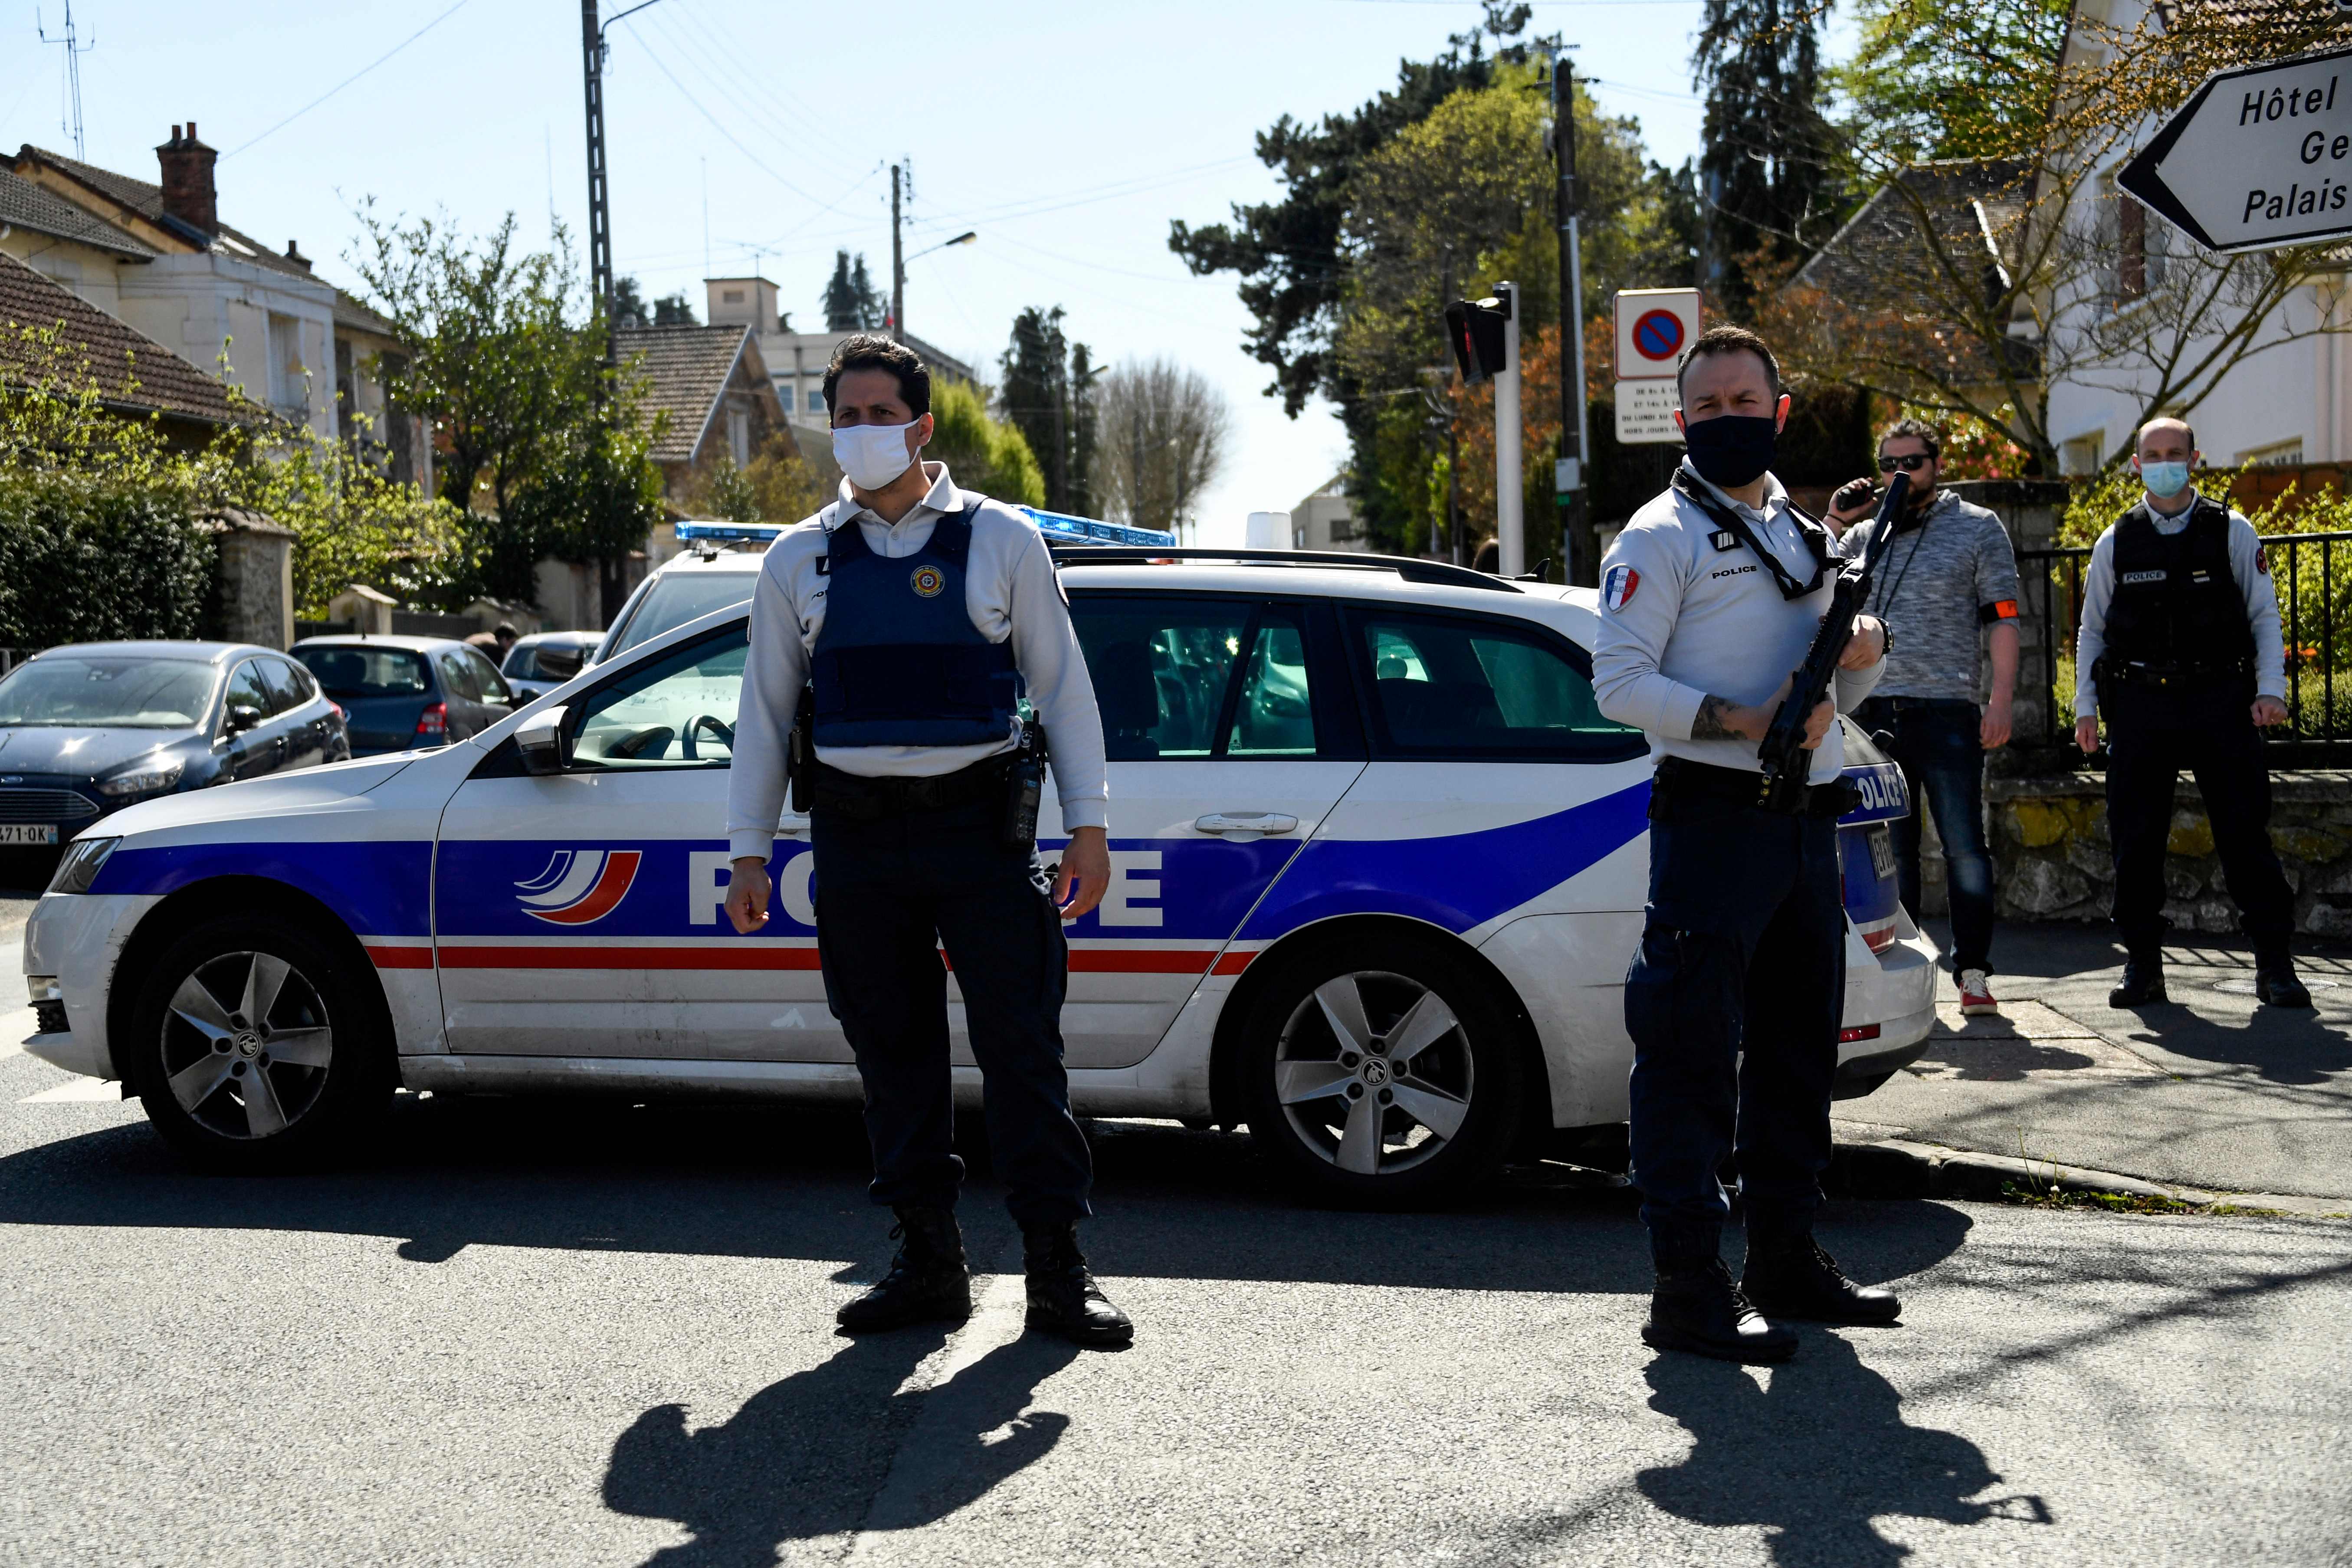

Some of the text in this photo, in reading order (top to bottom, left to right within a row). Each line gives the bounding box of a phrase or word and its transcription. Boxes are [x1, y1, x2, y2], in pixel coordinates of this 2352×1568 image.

[2239, 76, 2338, 126] Hôtel
[2300, 131, 2349, 164] Ge
[2242, 178, 2347, 223] Palais
[1712, 566, 1757, 579] POLICE
[2126, 571, 2163, 581] POLICE
[1849, 774, 1901, 814] OLICE
